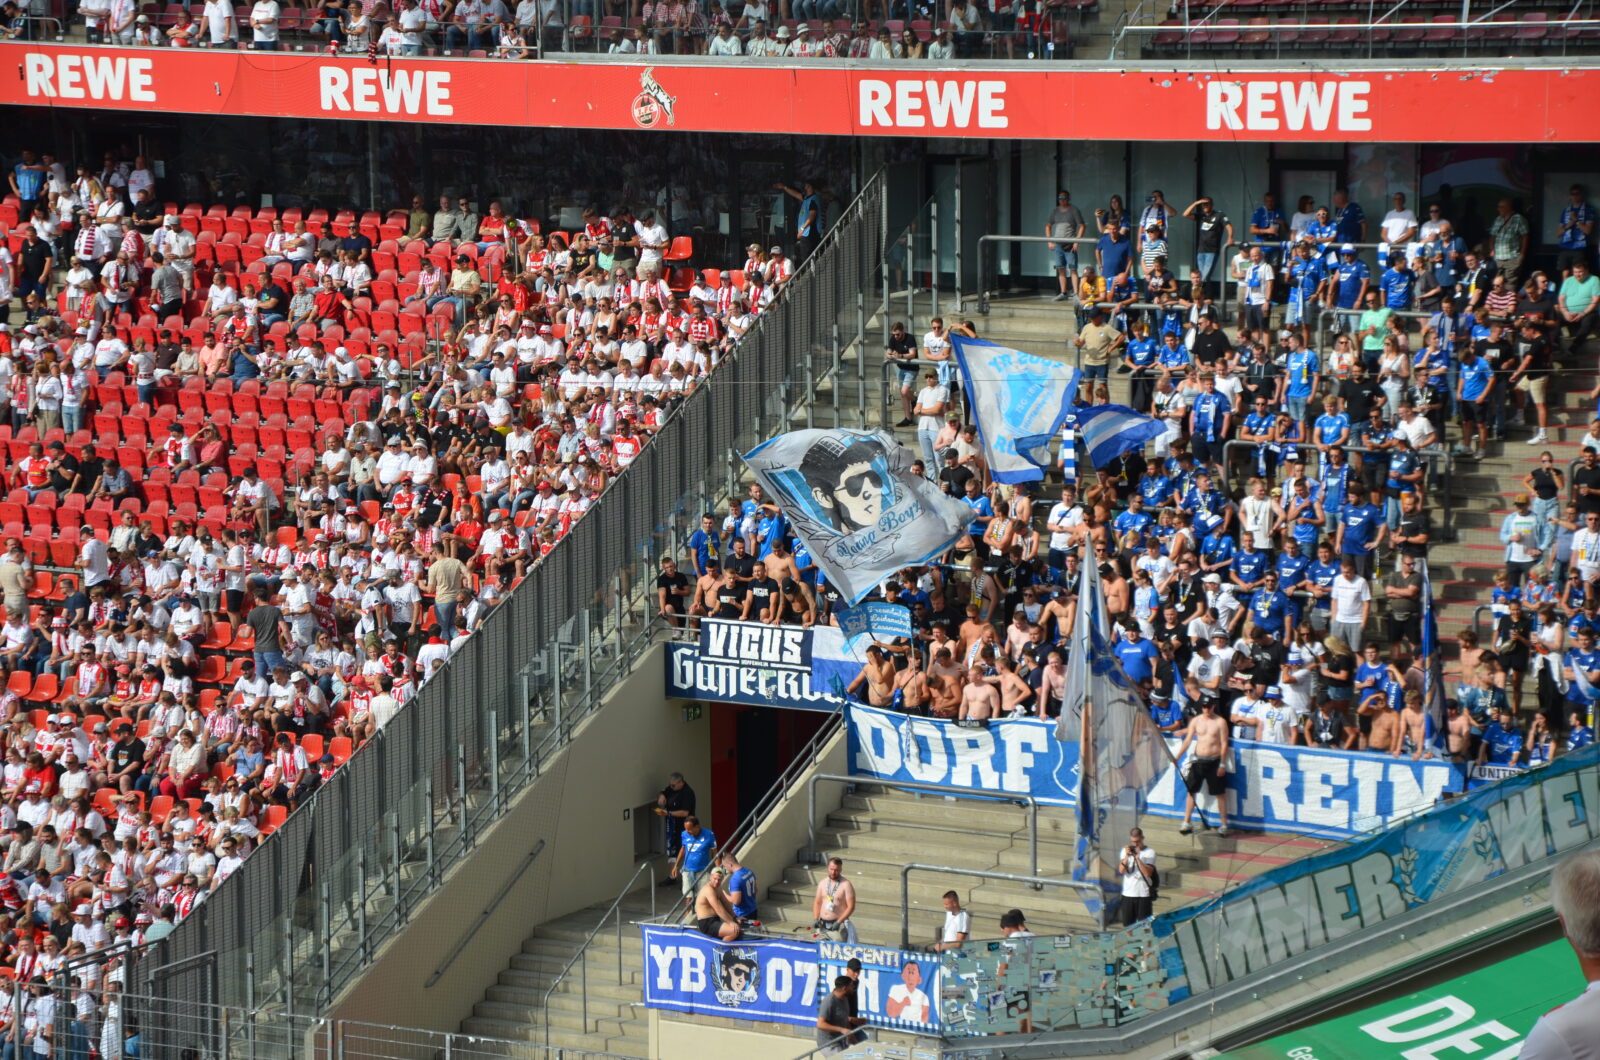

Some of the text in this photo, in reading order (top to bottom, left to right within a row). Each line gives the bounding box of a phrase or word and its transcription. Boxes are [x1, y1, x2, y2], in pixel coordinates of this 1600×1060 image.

[26, 53, 156, 102] REWE
[319, 66, 453, 116] REWE
[858, 79, 1008, 129] REWE
[1206, 80, 1372, 132] REWE
[708, 622, 804, 665] VICUS
[853, 711, 1049, 793] DORF
[1174, 848, 1408, 997] IMMER
[649, 945, 706, 993] YB
[766, 957, 820, 1007] 07
